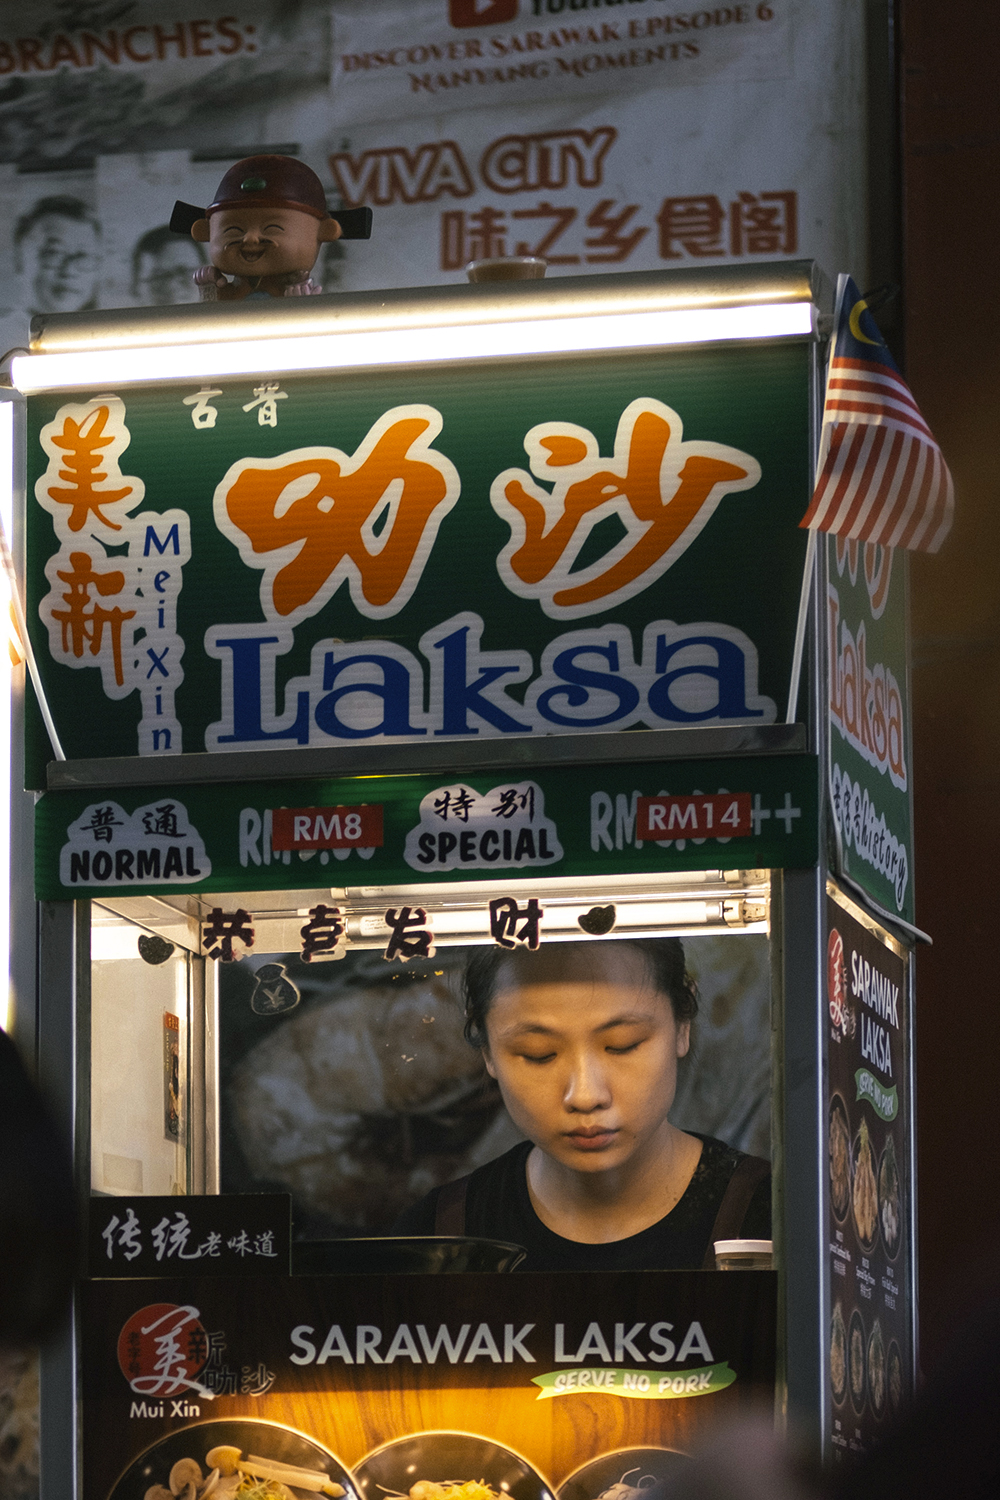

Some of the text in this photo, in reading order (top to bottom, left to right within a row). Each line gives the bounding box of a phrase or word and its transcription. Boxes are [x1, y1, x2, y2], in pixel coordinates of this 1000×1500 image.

[342, 39, 484, 72] DISCOVER
[491, 21, 621, 60] SARAWAK
[629, 4, 750, 39] EPISODE
[756, 1, 774, 21] 6
[408, 40, 700, 94] NANYANG MOMENTS
[329, 126, 616, 207] VIVA CITY
[440, 190, 797, 271] 味之乡食阁
[223, 410, 750, 616] 叻沙
[46, 404, 137, 689] 美新
[215, 625, 764, 745] Laksa
[829, 600, 905, 780] Laksa
[80, 804, 186, 844] 普通
[293, 813, 362, 841] RM8
[417, 828, 554, 864] SPECIAL
[648, 801, 740, 831] RM14
[71, 846, 201, 882] NORMAL
[201, 897, 544, 962] 恭喜发财
[851, 950, 899, 1030] SARAWAK
[861, 1012, 893, 1078] LAKSA
[289, 1321, 714, 1366] SARAWAK LAKSA
[130, 1400, 200, 1418] Mui Xin
[554, 1370, 712, 1394] SERVE NO PORK
